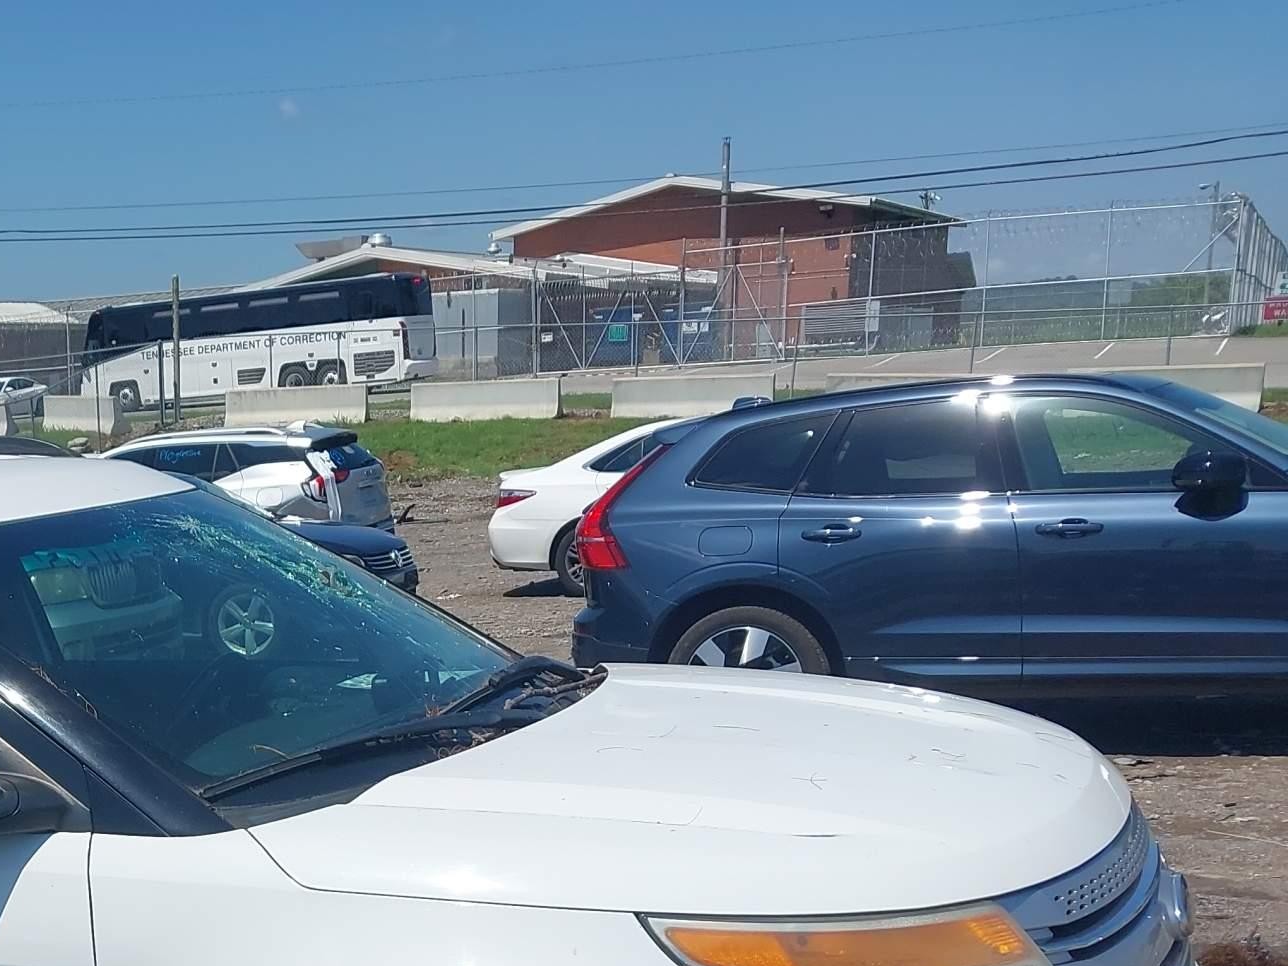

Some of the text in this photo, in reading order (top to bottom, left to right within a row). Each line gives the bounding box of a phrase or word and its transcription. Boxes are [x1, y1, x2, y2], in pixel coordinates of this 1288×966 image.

[141, 346, 194, 360] TENESSEE
[198, 340, 260, 354] DEPARTMENT
[263, 338, 277, 347] OF
[280, 331, 346, 346] CORRECTION
